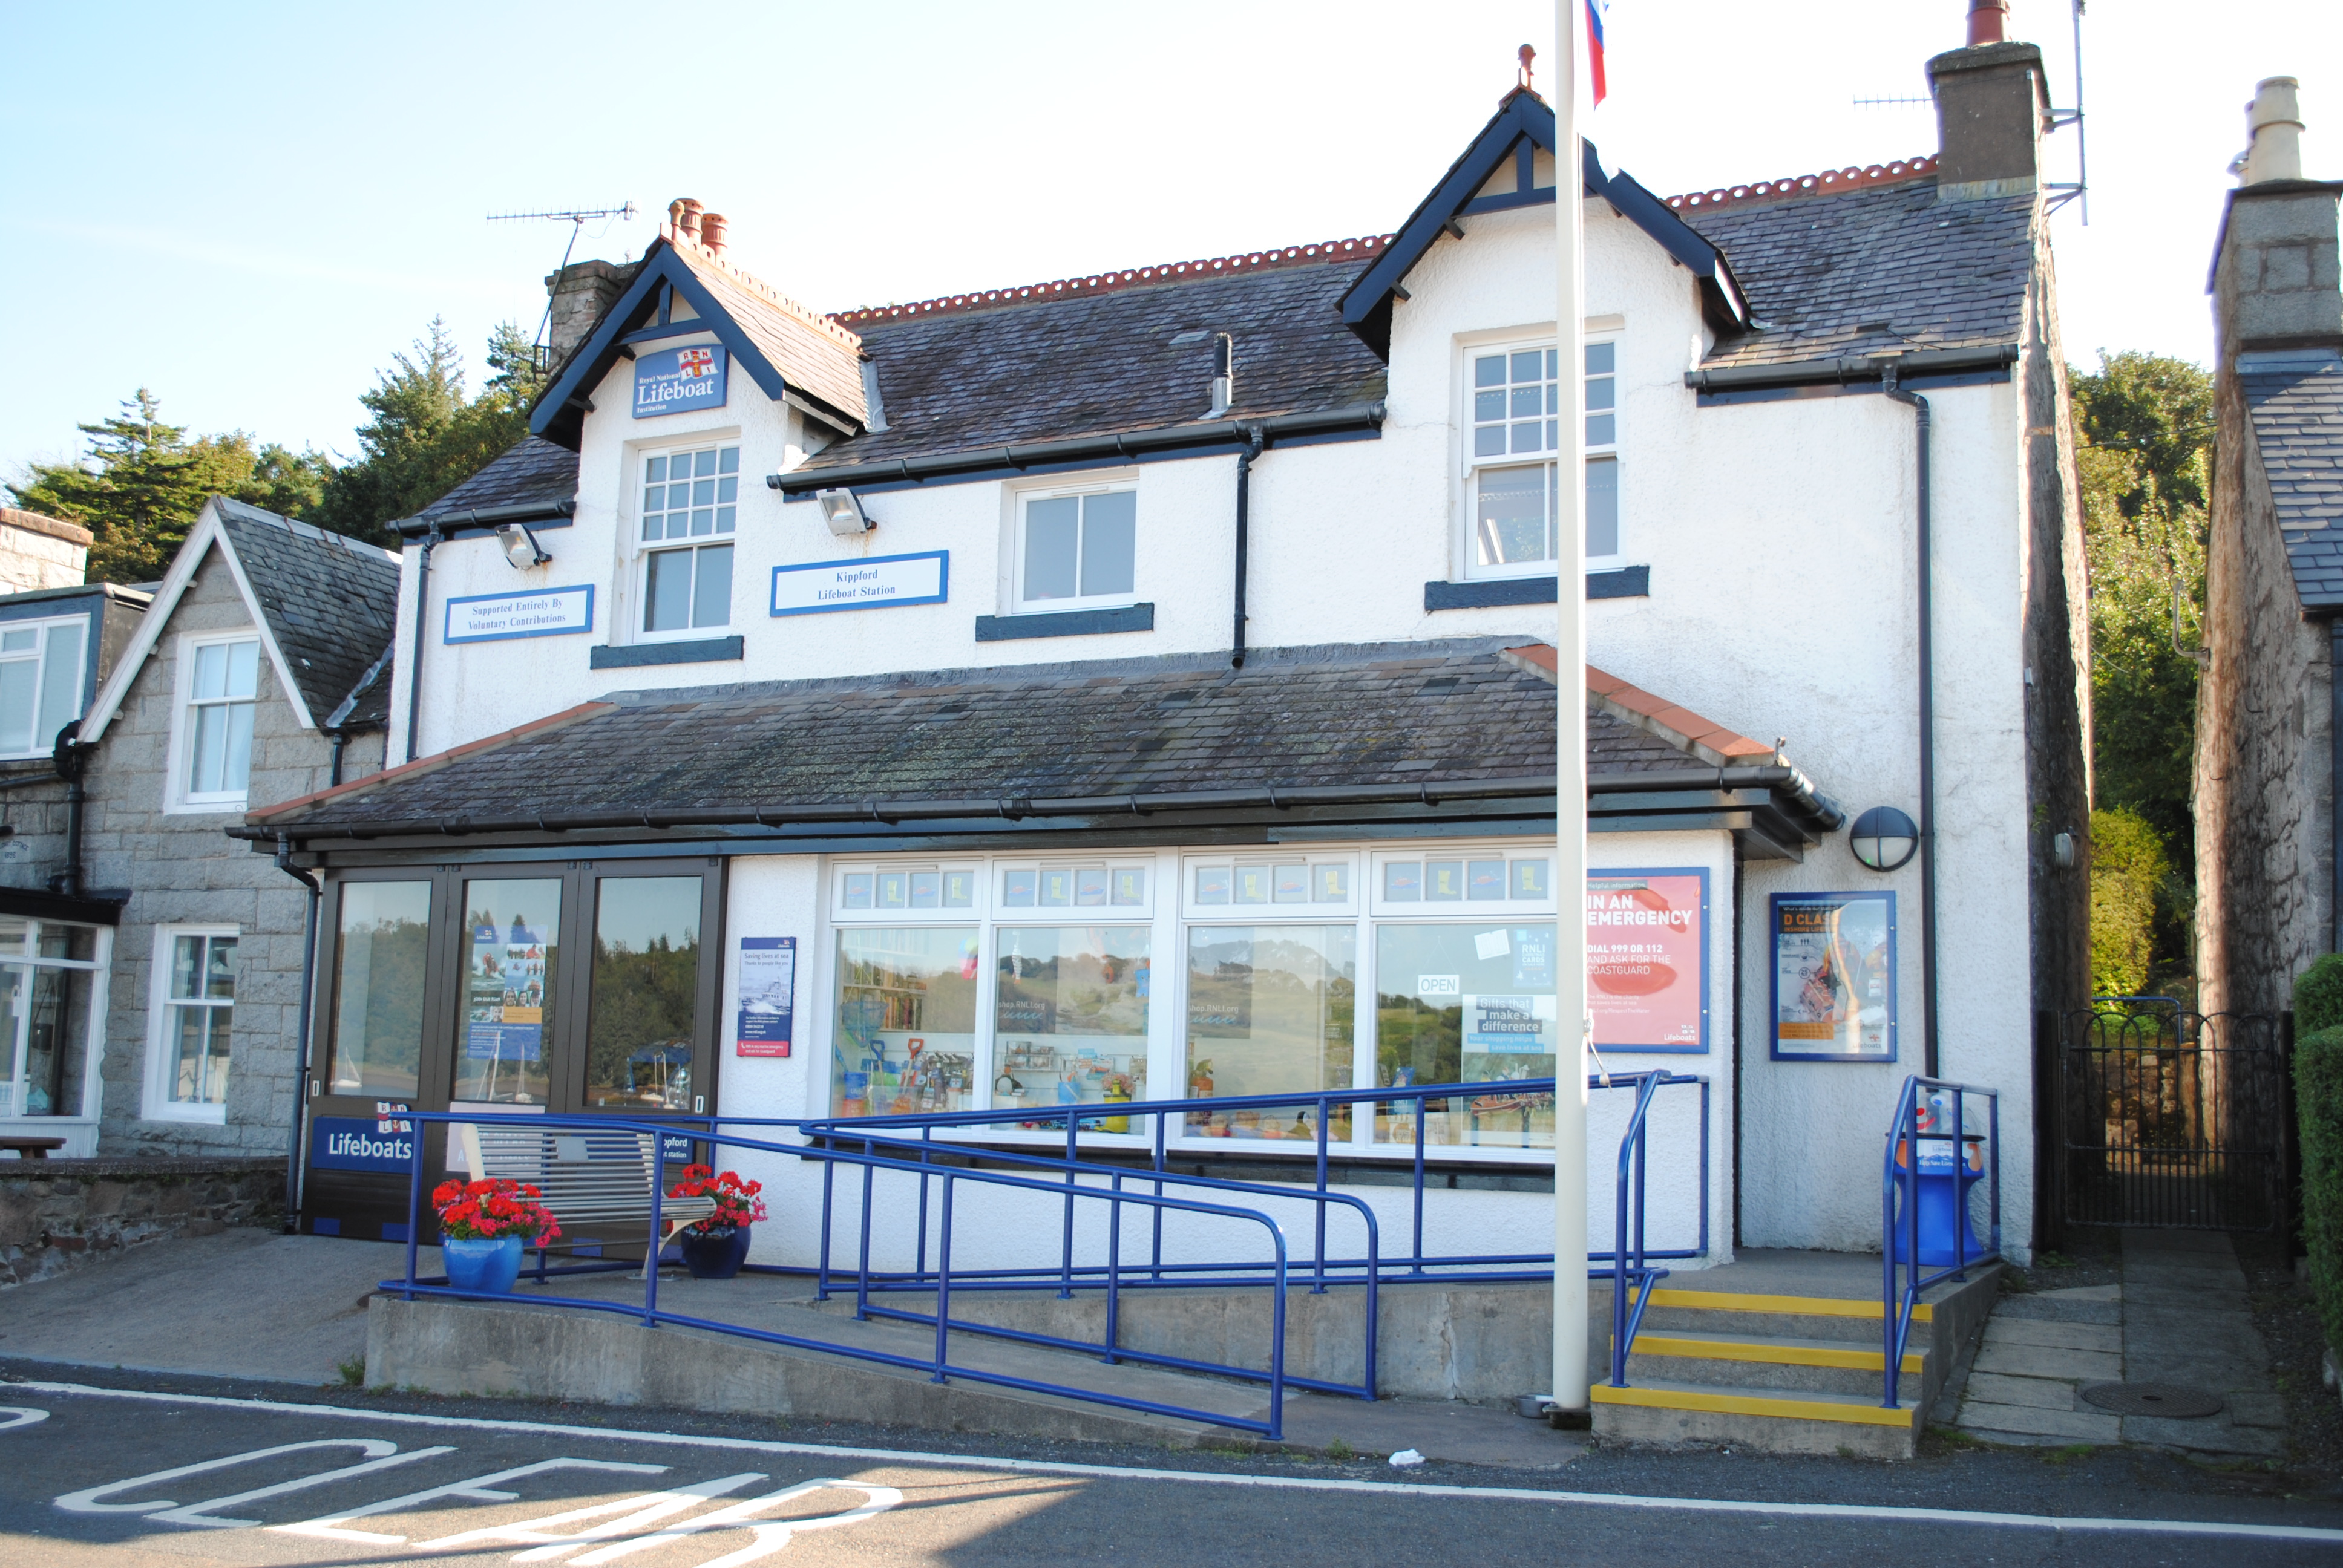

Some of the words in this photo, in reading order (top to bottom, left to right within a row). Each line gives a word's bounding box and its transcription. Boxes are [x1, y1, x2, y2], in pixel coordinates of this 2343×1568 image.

[639, 376, 655, 384] Royal
[656, 371, 681, 382] National
[637, 378, 715, 405] Lifeboat
[637, 403, 667, 414] Institution
[836, 569, 878, 584] Kippford
[818, 588, 856, 601] Lifeboat
[860, 585, 896, 597] Station
[472, 603, 513, 616] Supported
[516, 599, 549, 612] Entirely
[552, 598, 563, 609] By
[468, 620, 507, 630] Voluntary
[510, 613, 566, 627] Contributions
[1587, 895, 1604, 909] IN
[1608, 895, 1633, 909] AN
[1587, 910, 1693, 926] EMERGENCY
[1784, 914, 1793, 925] D
[1522, 944, 1545, 953] RNLI
[1587, 944, 1609, 953] DIAL
[1611, 944, 1628, 953] 999
[1630, 944, 1643, 953] OR
[1645, 944, 1663, 953] 112
[1587, 955, 1607, 964] AND
[1609, 955, 1628, 964] ASK
[1631, 955, 1650, 964] FOR
[1653, 955, 1671, 964] THE
[1587, 965, 1650, 975] COASTGUARD
[1421, 979, 1456, 992] OPEN
[998, 1000, 1046, 1010] shop.RNLI.org
[1480, 998, 1506, 1008] Gifts
[1509, 998, 1530, 1008] that
[1489, 1010, 1520, 1020] make
[1481, 1021, 1539, 1031] difference
[329, 1132, 413, 1159] Lifeboats
[53, 1439, 904, 1568] CLEAR
